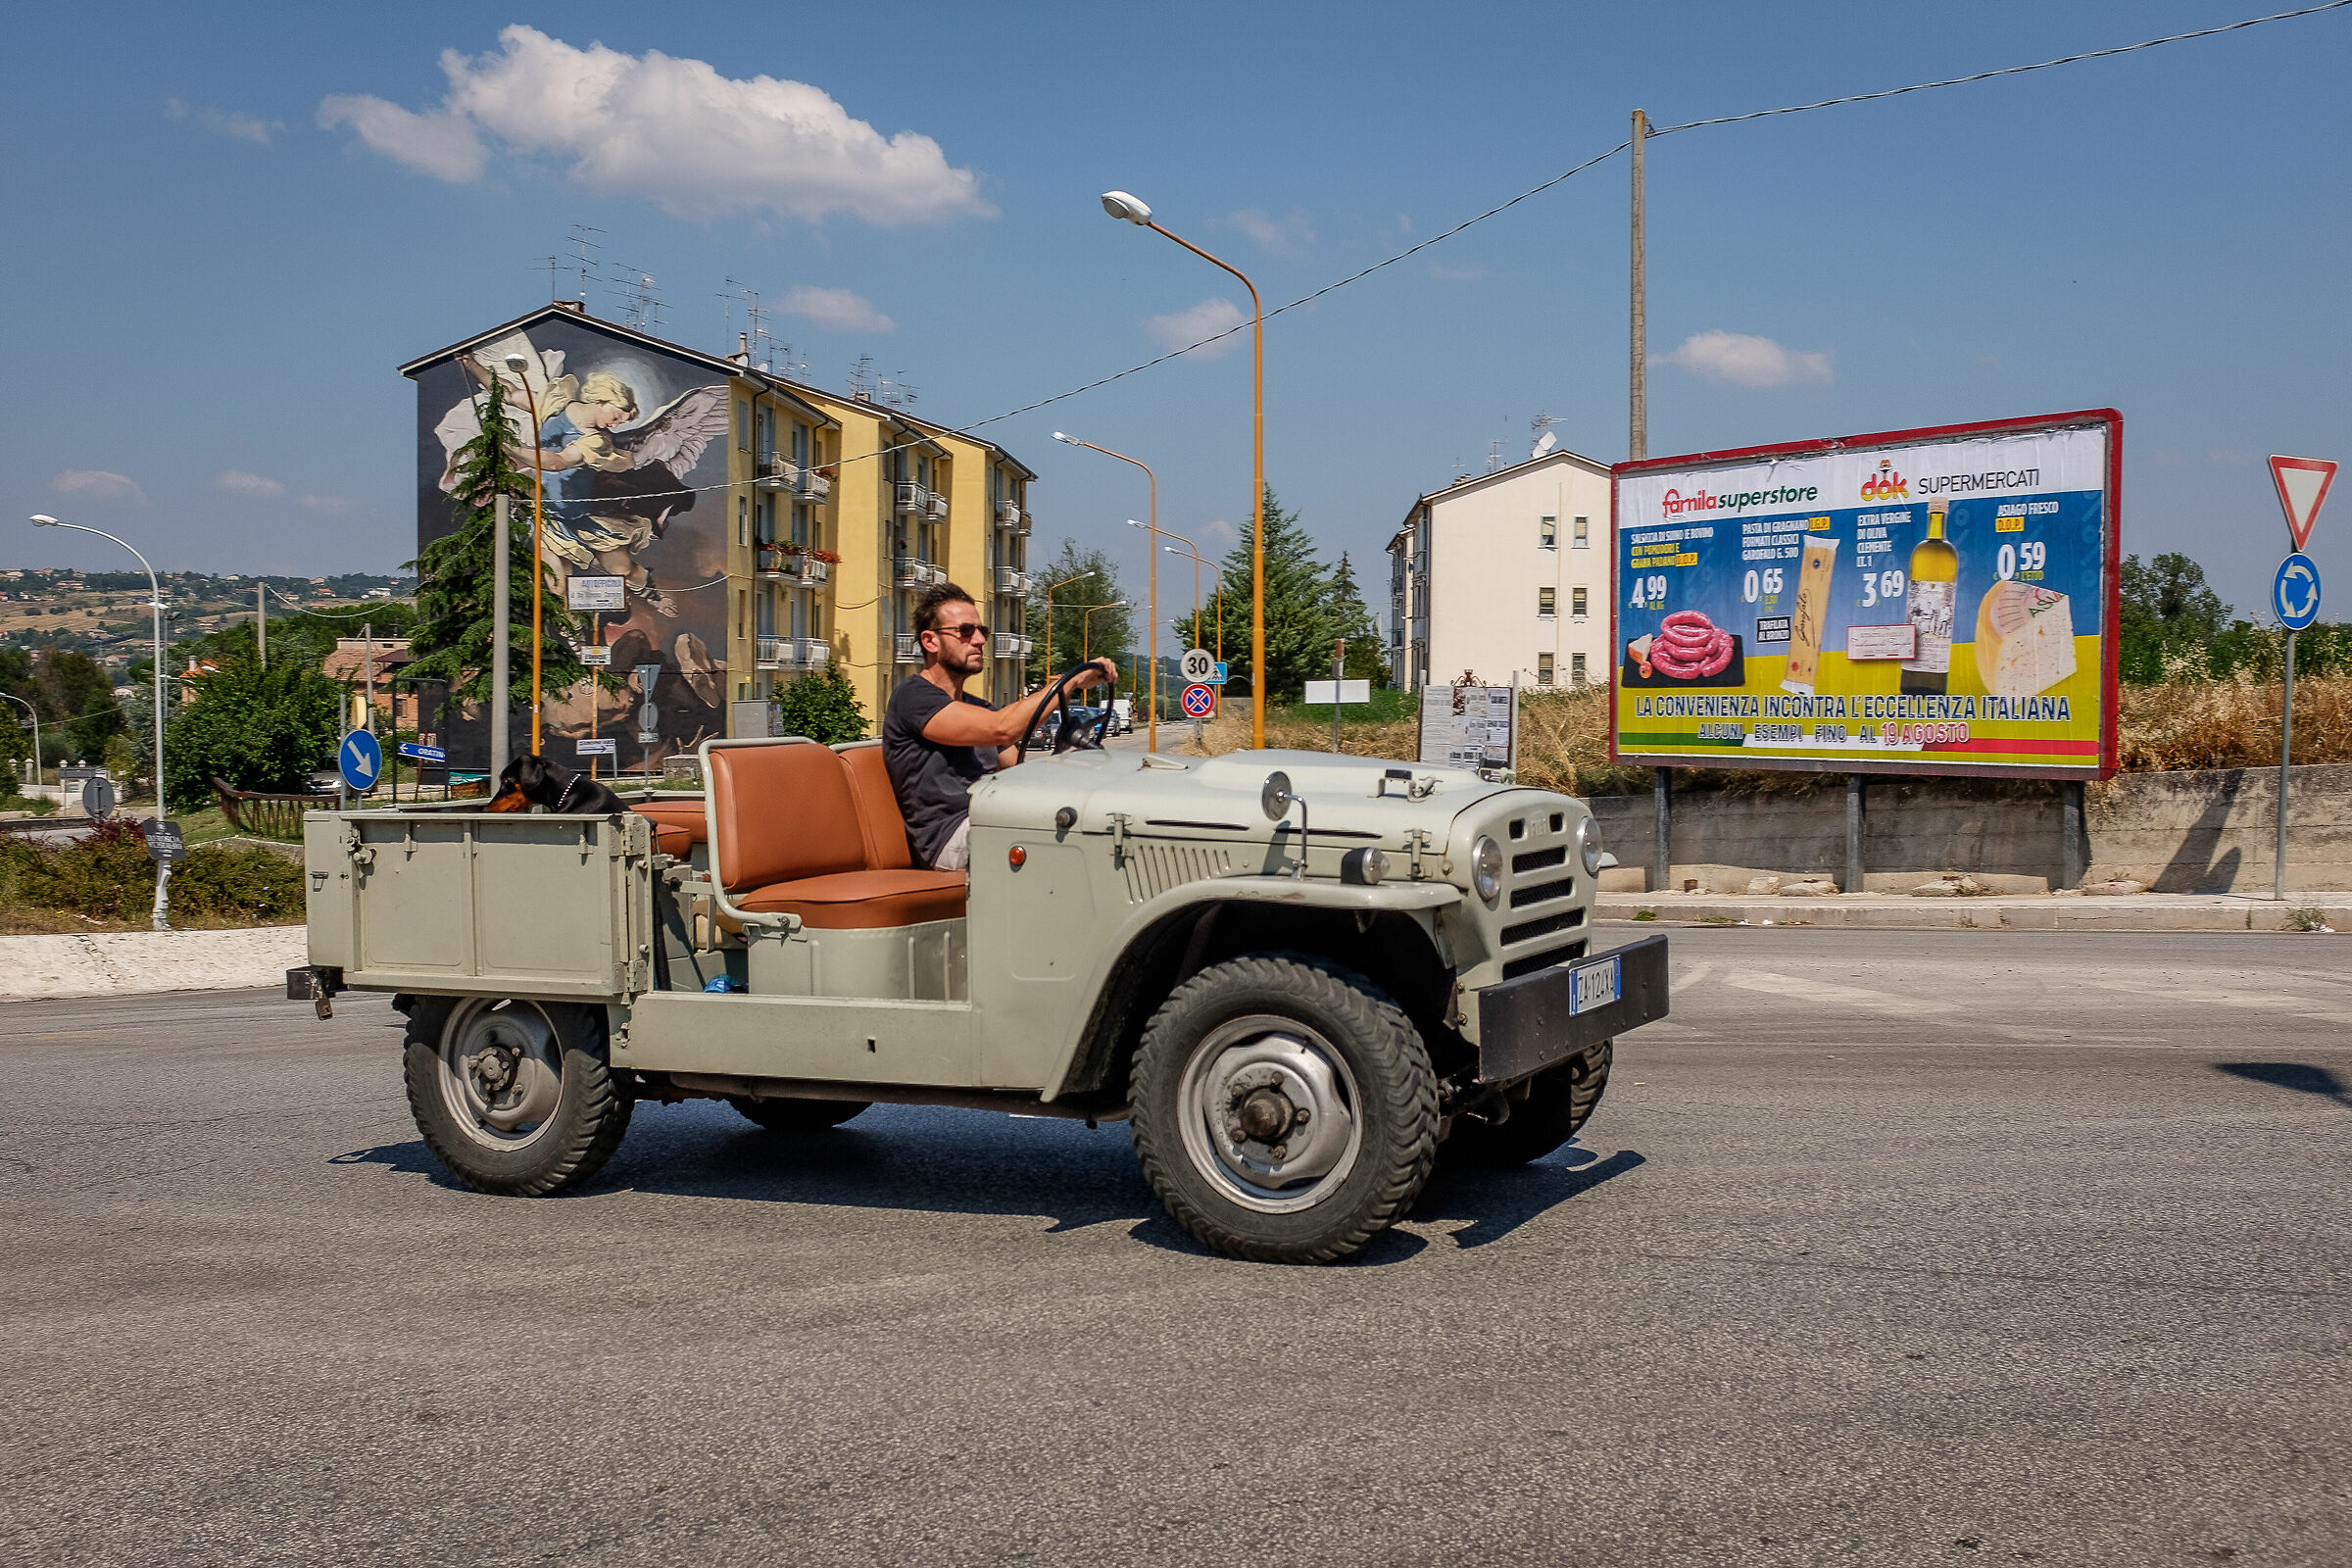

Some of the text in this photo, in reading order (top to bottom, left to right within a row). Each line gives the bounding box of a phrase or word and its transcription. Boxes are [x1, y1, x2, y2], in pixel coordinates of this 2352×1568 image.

[1861, 470, 1910, 502] dok
[1918, 468, 2039, 494] SUPERMERCATI
[1662, 485, 1818, 518] famila superstore
[1997, 501, 2059, 517] ASIAGO FRESCO
[1742, 522, 1763, 535] PASTA
[1763, 521, 1771, 533] DI
[1772, 519, 1809, 532] GRAGNANO
[1857, 512, 1911, 526] EXTRA VERGINE
[1742, 533, 1799, 548] FORMATI CLASSICI
[1857, 526, 1887, 540] DI OLIVA
[1741, 548, 1776, 561] GAROFALO
[1784, 546, 1799, 559] 500
[1856, 540, 1892, 554] CLEMENTE
[1188, 656, 1208, 675] 30
[1636, 695, 2072, 721] LA CONVENIENZA INCONTRA L'ECCELLENZA ITALIANA
[1698, 722, 1970, 745] ALCUNI ESEMPI FINO AL 19 AGOSTO
